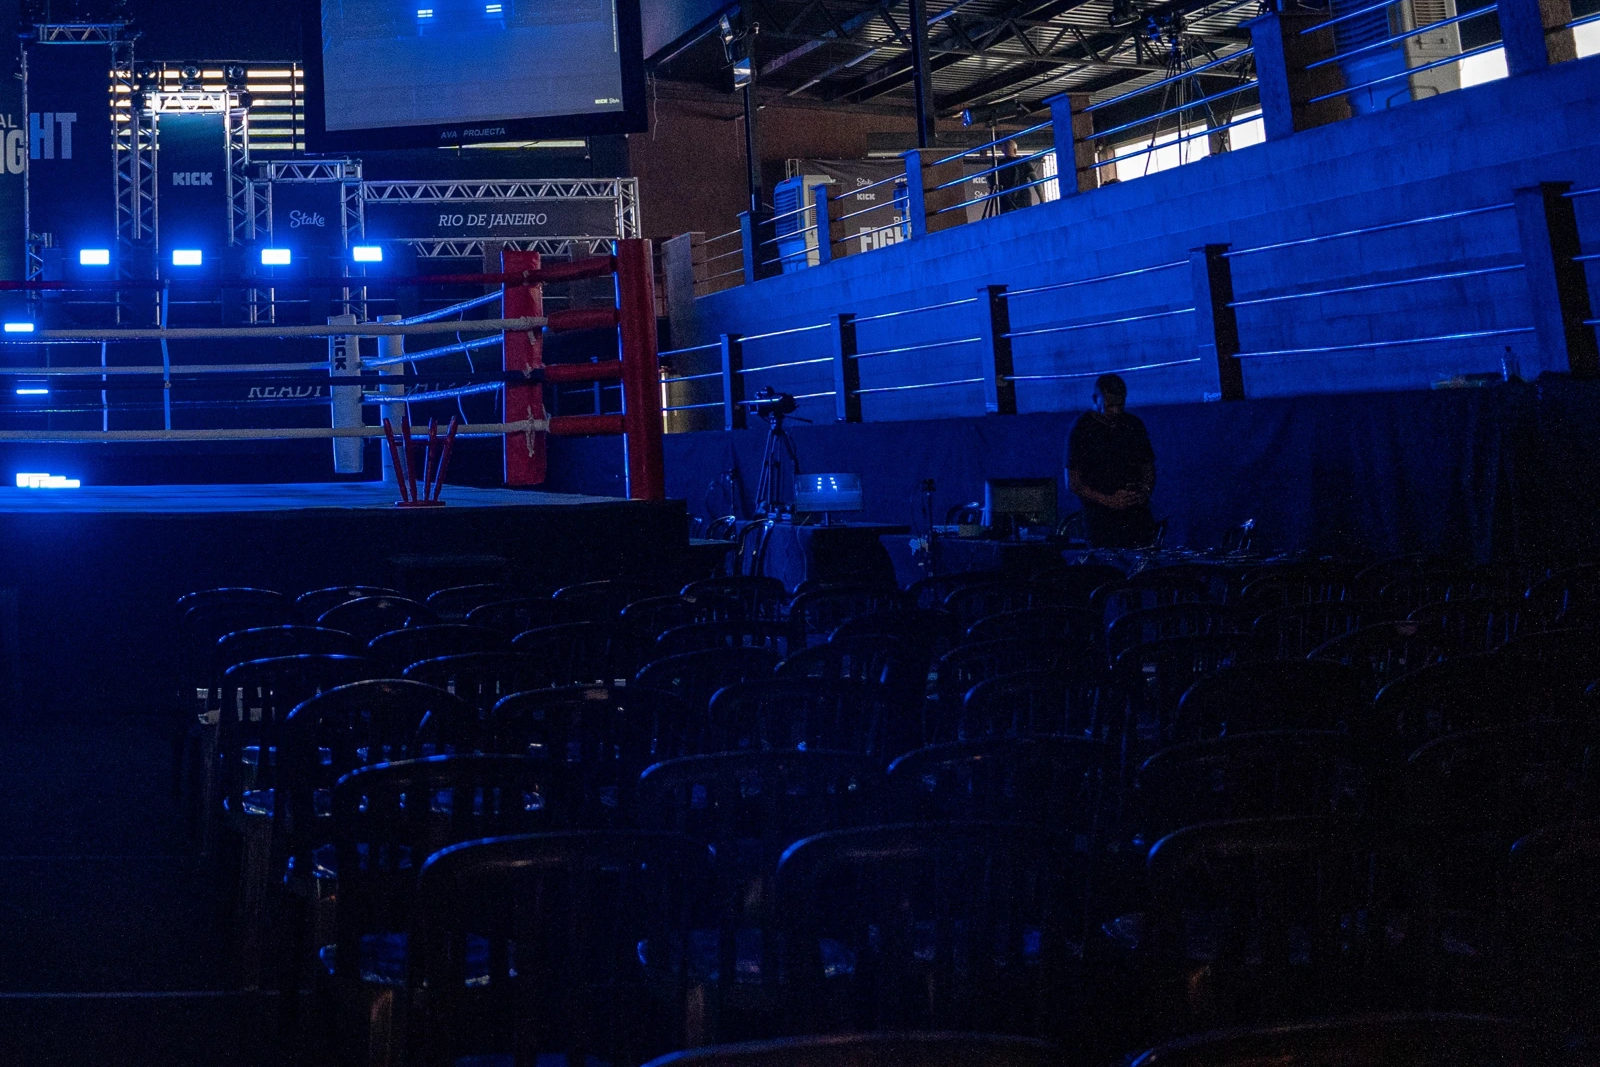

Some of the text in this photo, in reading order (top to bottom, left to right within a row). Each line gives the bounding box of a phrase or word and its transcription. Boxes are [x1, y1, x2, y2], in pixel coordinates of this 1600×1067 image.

[440, 127, 506, 139] AVA PROJECTA
[172, 172, 213, 186] KICK
[972, 176, 988, 184] KIC
[856, 193, 876, 201] KICK
[289, 210, 326, 229] Stake
[438, 213, 548, 229] RIO DE JANEIRO
